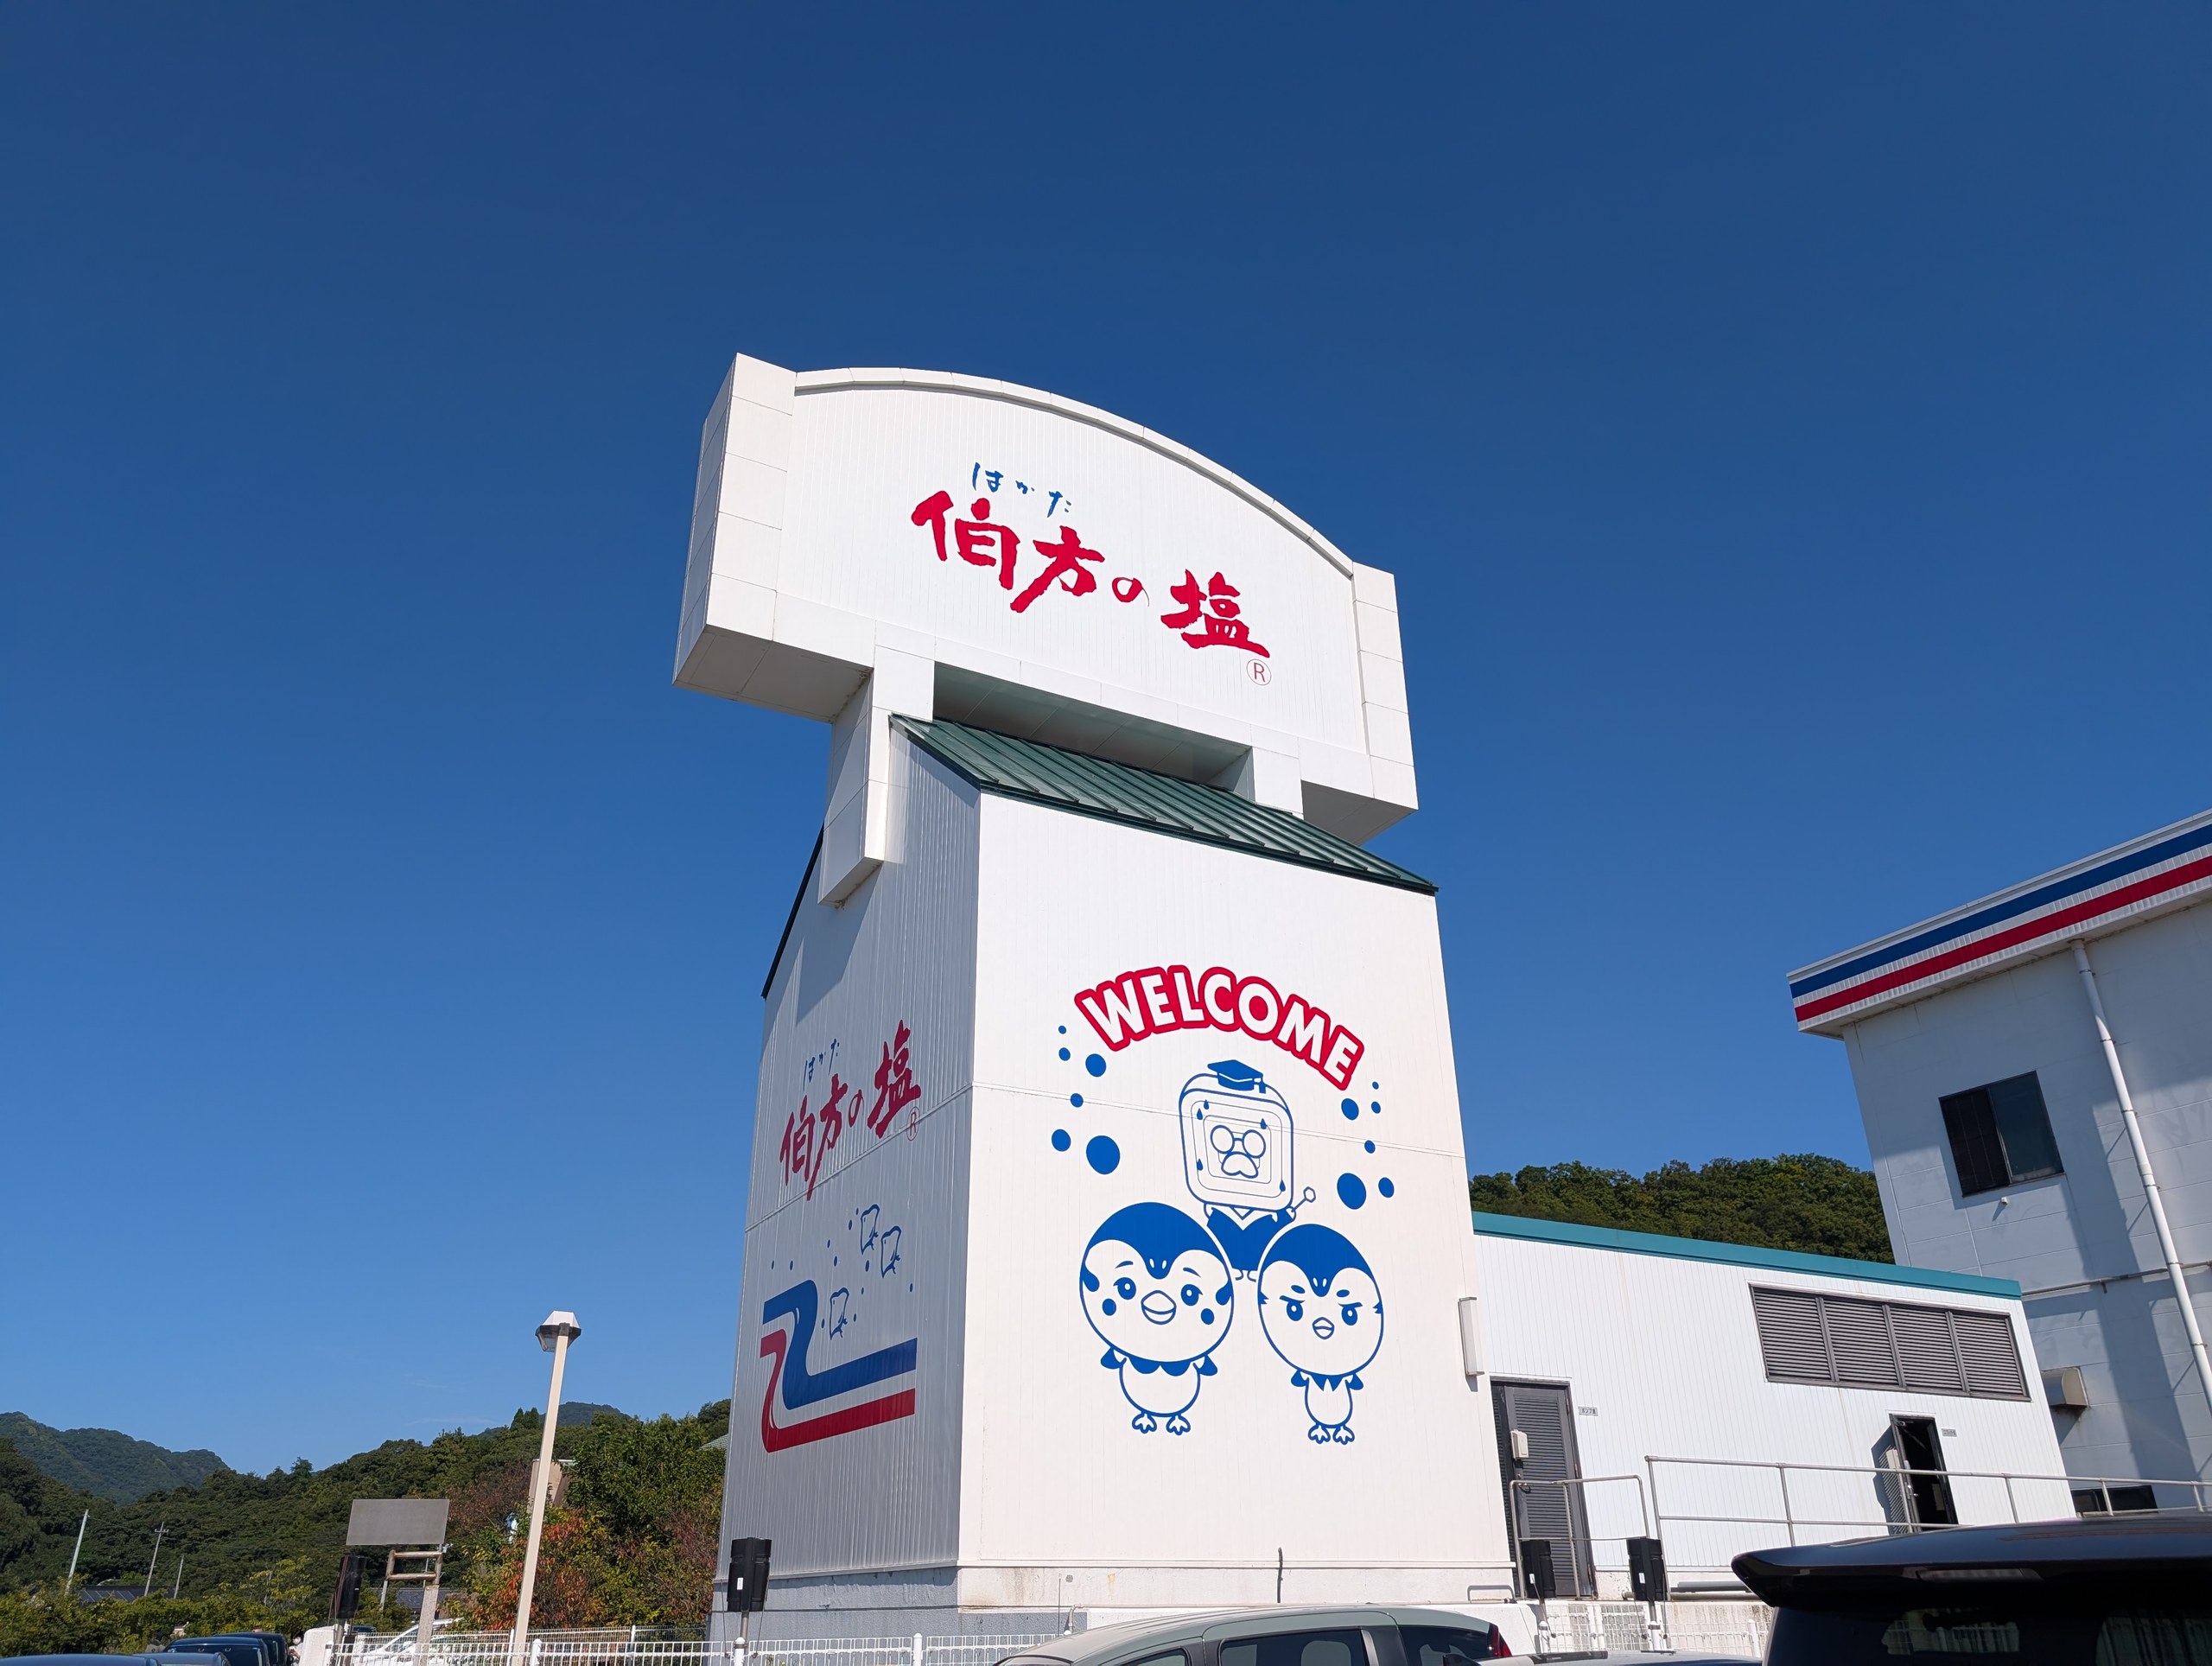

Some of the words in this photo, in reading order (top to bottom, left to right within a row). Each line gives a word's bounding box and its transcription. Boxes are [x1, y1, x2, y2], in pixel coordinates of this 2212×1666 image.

[972, 462, 1071, 518] はかた
[911, 490, 1270, 658] 伯方の塩
[804, 1039, 840, 1091] はかた
[1075, 965, 1364, 1091] WELCOME
[779, 1020, 921, 1201] 伯方の塩
